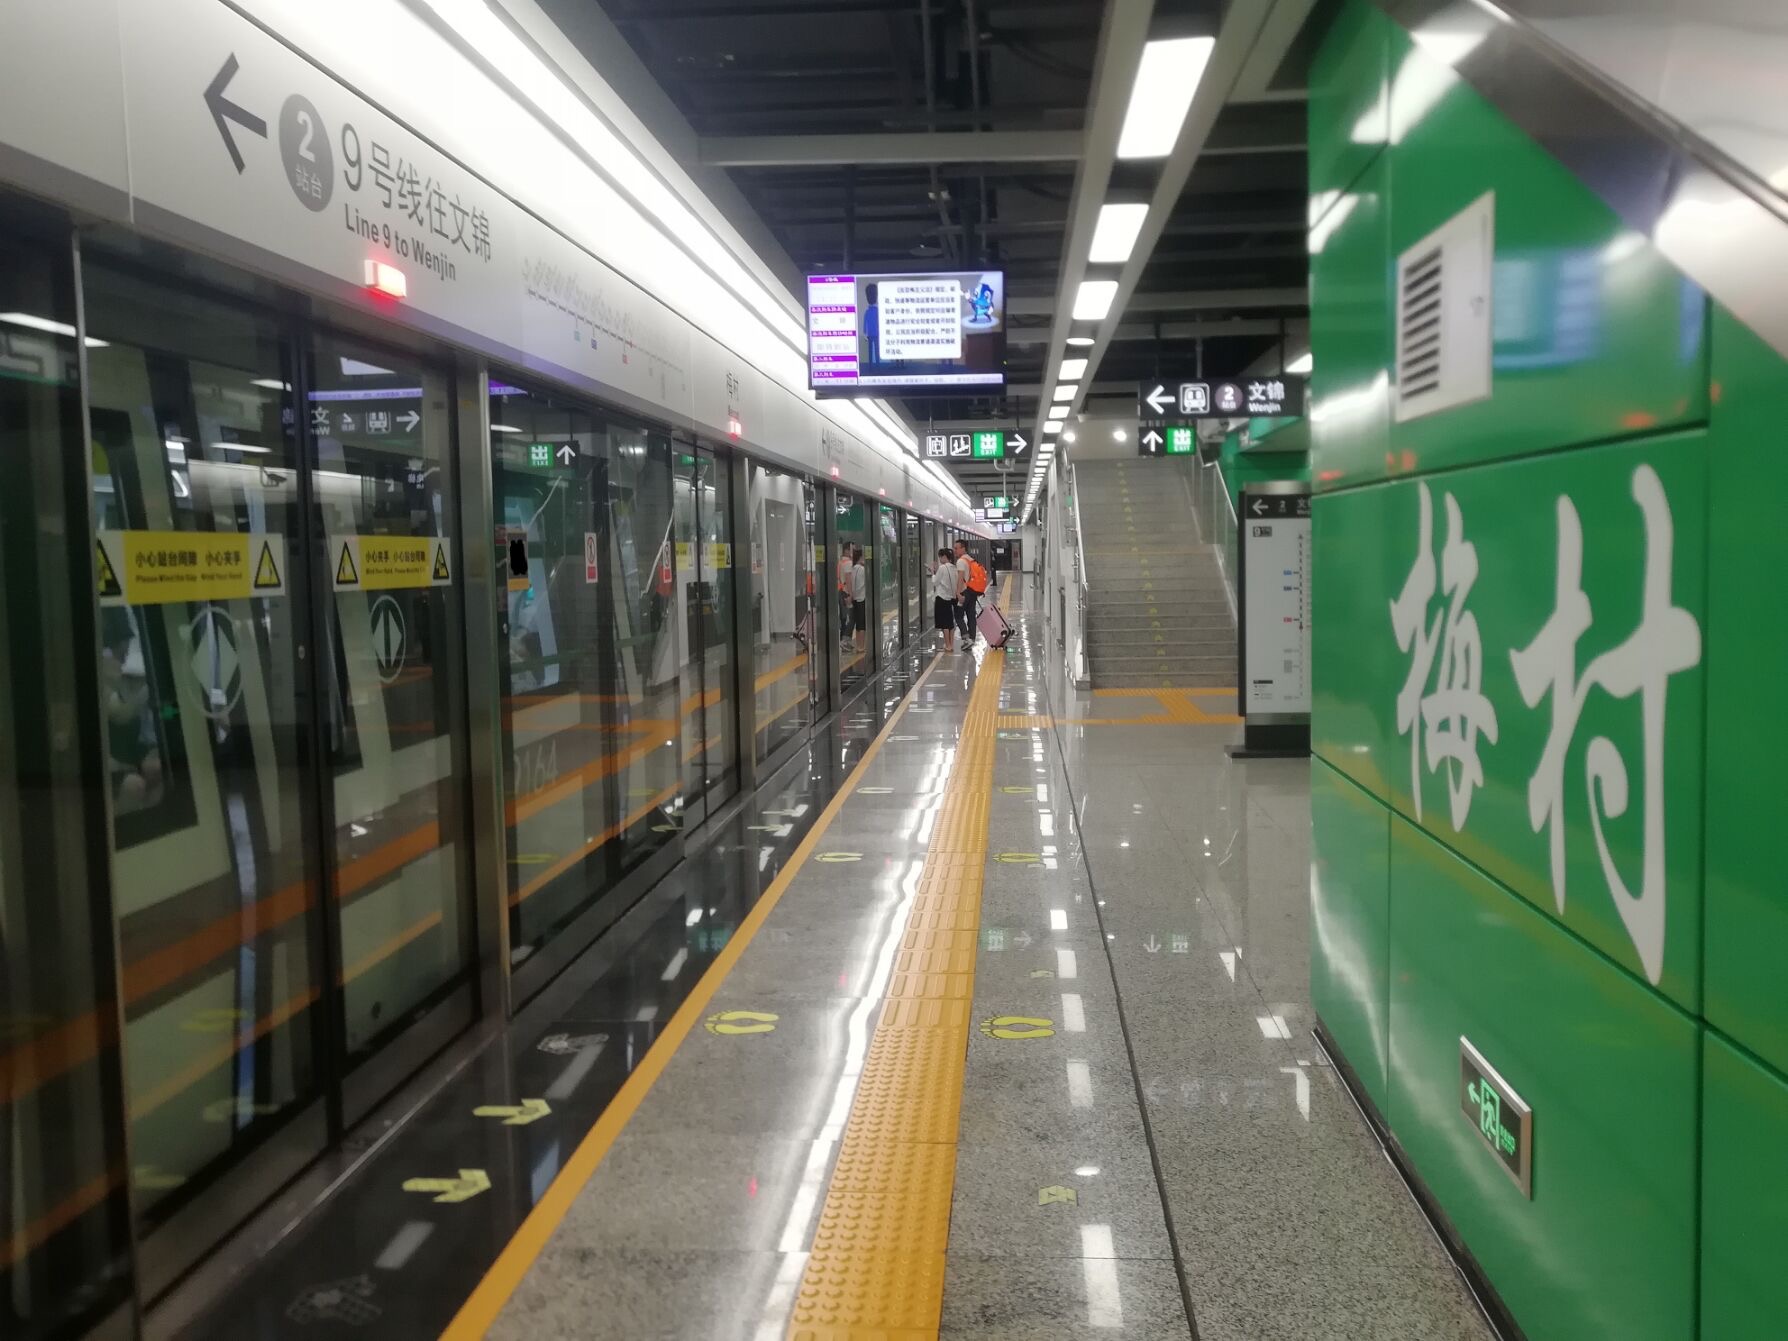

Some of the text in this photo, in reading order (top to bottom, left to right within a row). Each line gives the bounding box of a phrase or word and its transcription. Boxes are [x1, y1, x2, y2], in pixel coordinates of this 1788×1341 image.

[297, 110, 316, 163] 2
[295, 163, 322, 200] 站台
[341, 122, 491, 263] 9号线往文锦
[345, 203, 456, 281] Line 9 to Wenjin
[1224, 387, 1234, 400] 2
[1248, 380, 1285, 401] 文锦
[1248, 402, 1281, 414] Wenjin
[1390, 464, 1702, 986] 梅村
